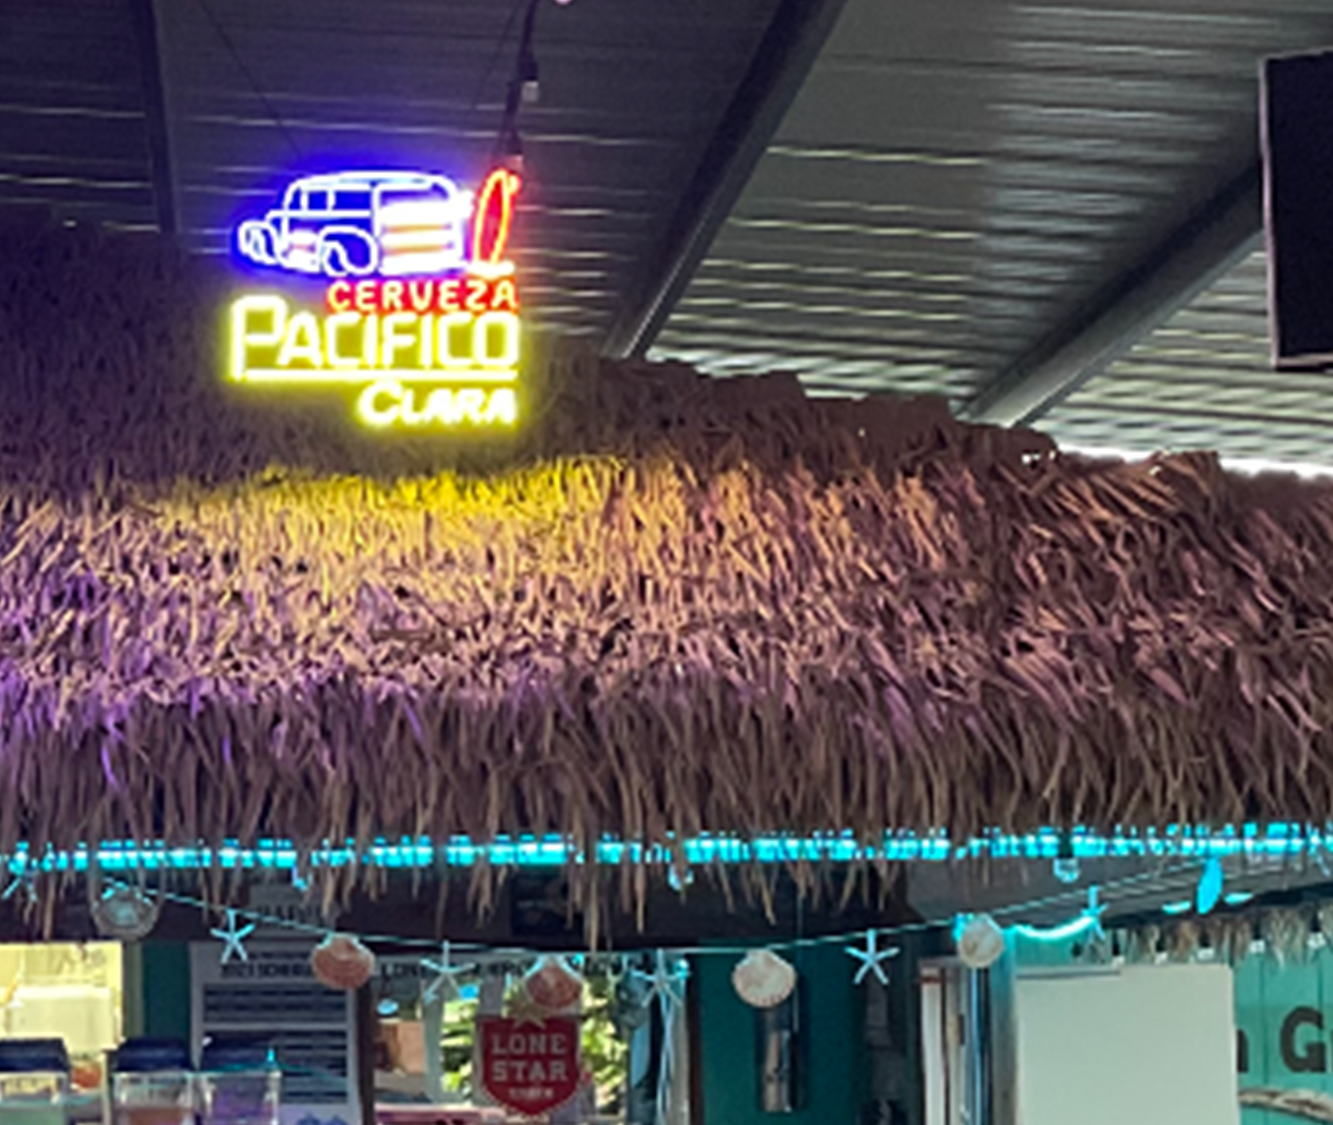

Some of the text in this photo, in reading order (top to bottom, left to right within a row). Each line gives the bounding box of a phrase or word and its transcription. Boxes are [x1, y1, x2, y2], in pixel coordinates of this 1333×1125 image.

[328, 280, 517, 312] CERVEZA
[230, 294, 520, 381] PACIFICO
[492, 1033, 568, 1055] LONE
[492, 1061, 568, 1083] STAR
